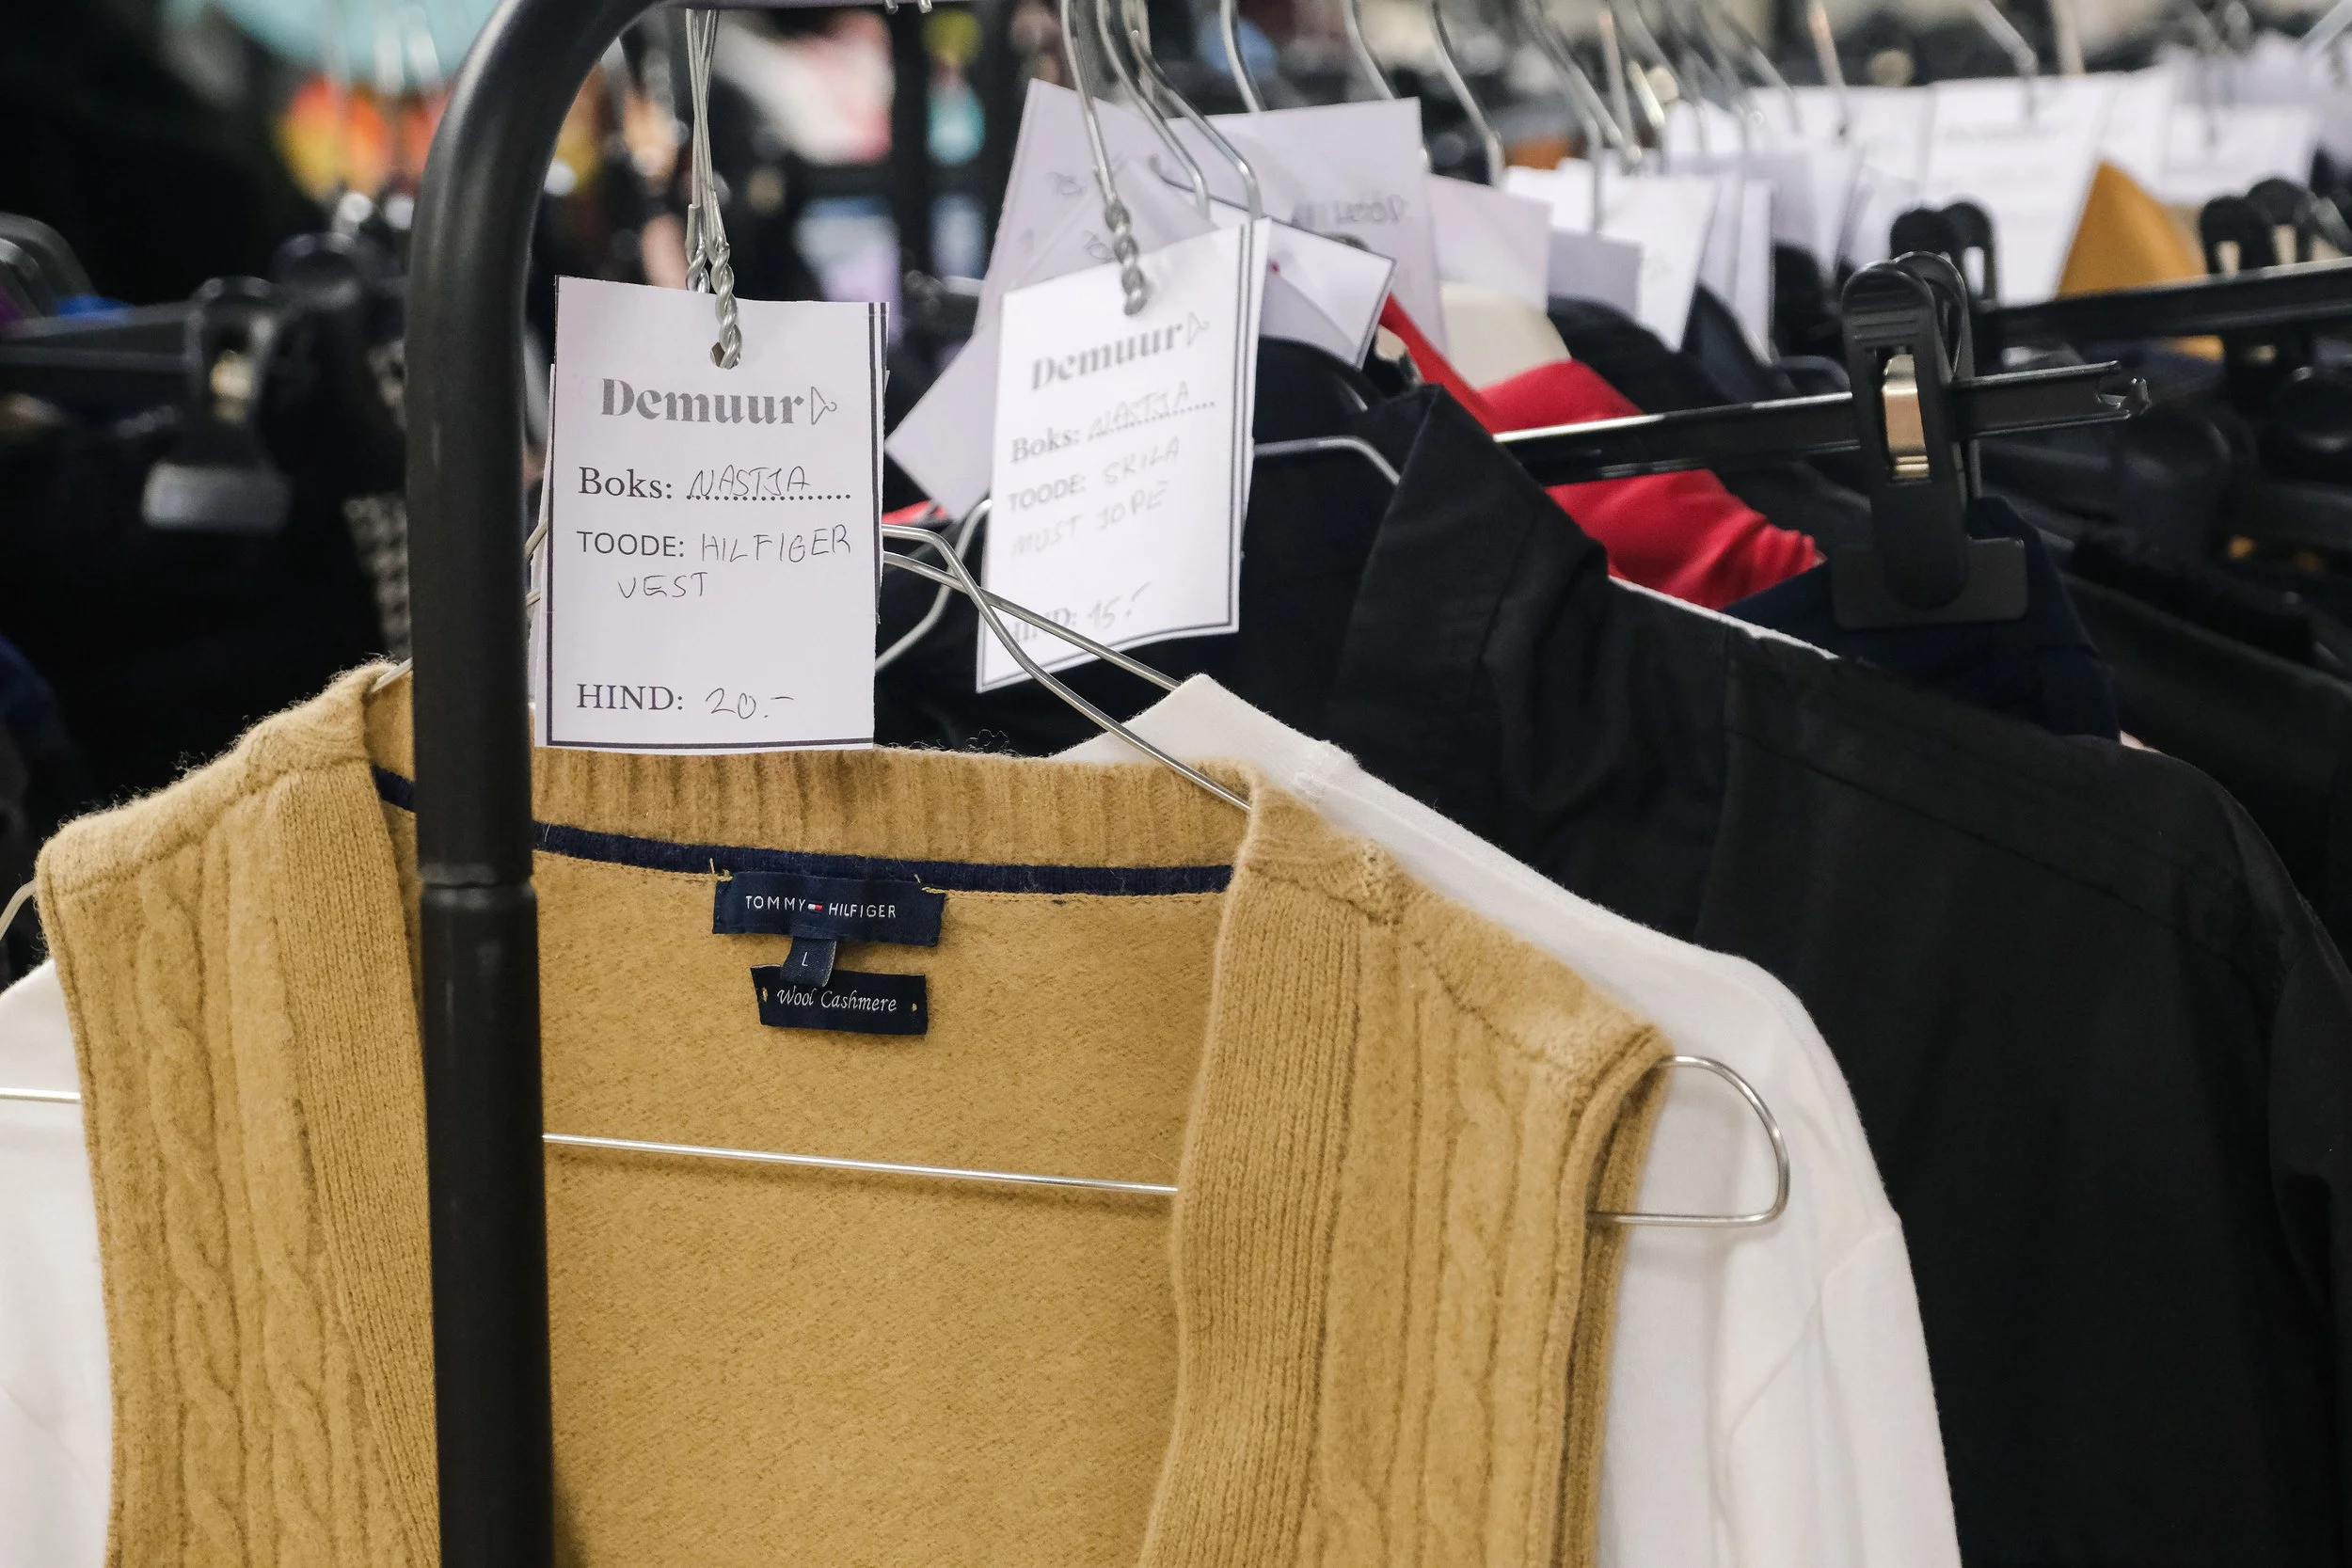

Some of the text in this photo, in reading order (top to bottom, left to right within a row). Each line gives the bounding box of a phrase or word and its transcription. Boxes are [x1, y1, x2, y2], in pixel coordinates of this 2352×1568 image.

[1030, 323, 1184, 390] Demuur
[601, 378, 804, 424] Demuur
[1010, 427, 1081, 462] Boks:
[578, 467, 673, 499] Boks:
[1007, 472, 1087, 512] TOODE:
[577, 523, 851, 563] TOODE: HILFIGER
[617, 572, 708, 598] VEST
[576, 684, 684, 711] HIND:
[746, 895, 897, 919] TOMMY HILFIGER
[801, 951, 808, 967] L
[776, 985, 898, 1012] Wool Cashmere
